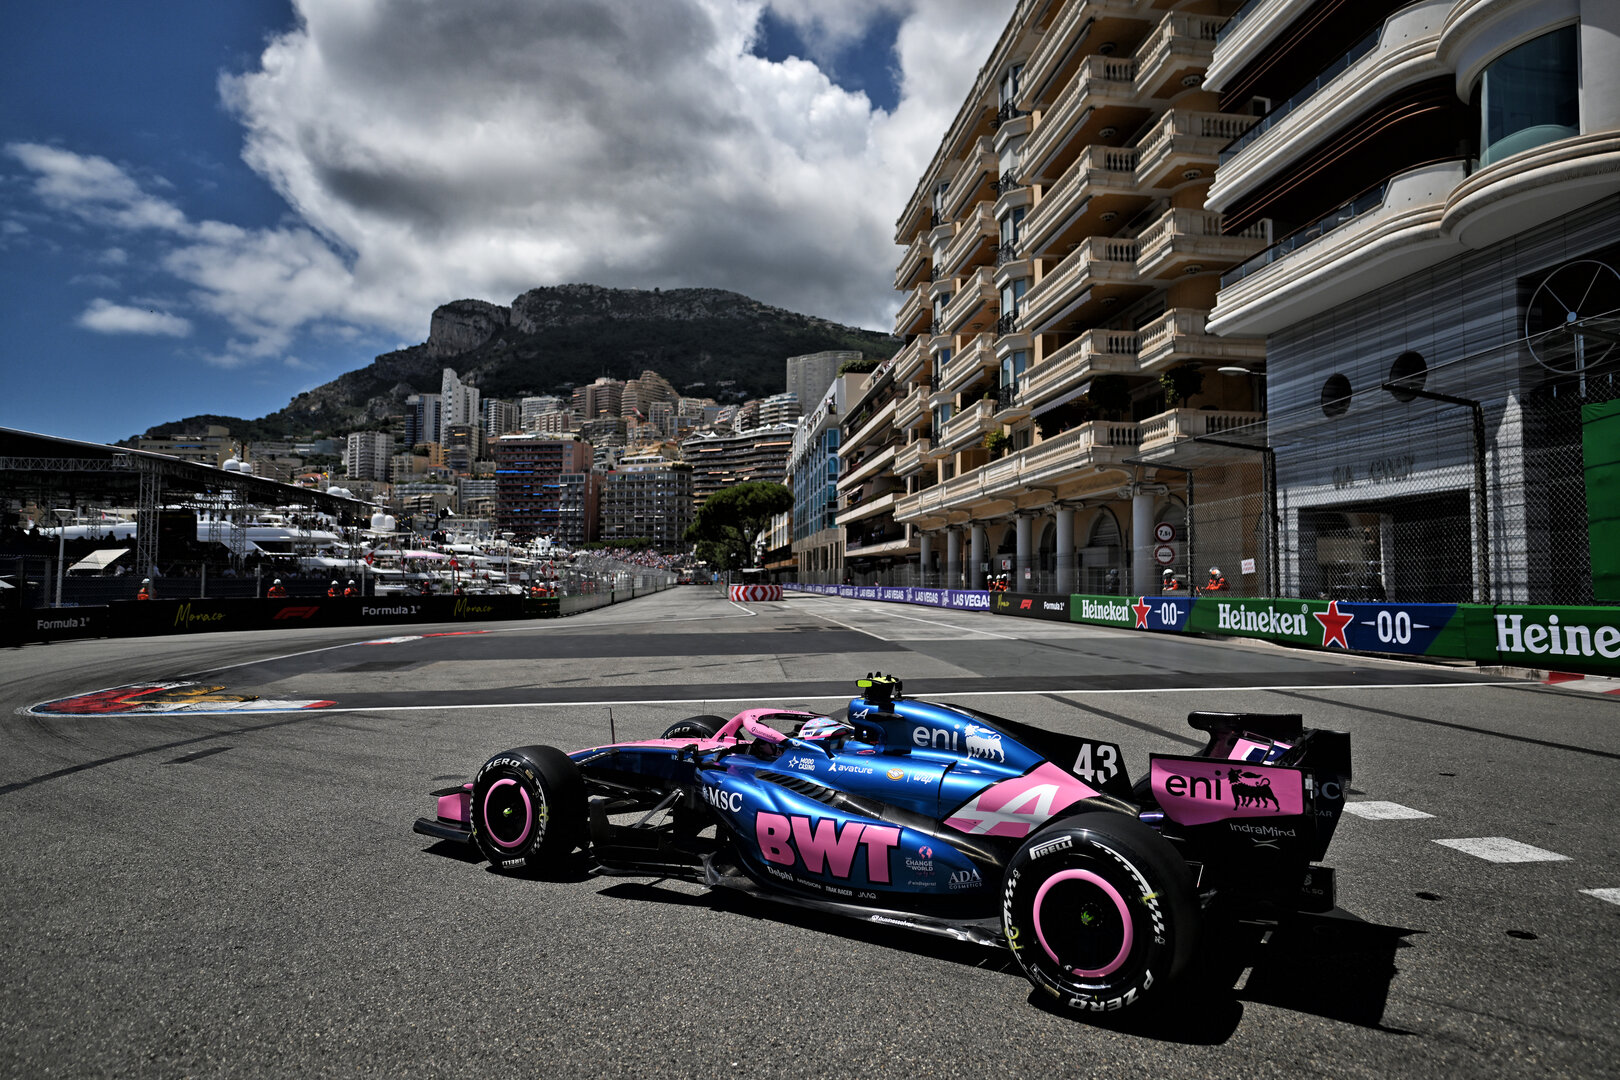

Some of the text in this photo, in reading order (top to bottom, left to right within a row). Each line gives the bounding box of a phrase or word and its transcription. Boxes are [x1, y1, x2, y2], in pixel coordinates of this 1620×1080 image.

[915, 591, 924, 602] LAS
[924, 592, 938, 603] VEGAS
[953, 594, 964, 606] LAS
[174, 602, 226, 629] Monaco
[362, 605, 408, 616] Formula
[453, 598, 493, 618] Monaco
[1161, 602, 1177, 625] 0.0
[37, 618, 78, 630] Formula
[1377, 610, 1412, 645] 0.0
[1493, 614, 1620, 659] Heine
[912, 724, 958, 751] eni
[485, 758, 521, 772] ZERO
[838, 764, 873, 774] avature
[1073, 743, 1118, 784] 43
[1165, 770, 1222, 800] eni
[708, 786, 743, 812] MSC
[1229, 822, 1296, 837] IndraMind
[755, 810, 903, 885] BWT
[1029, 835, 1073, 860] PIRELLI
[767, 866, 794, 882] Delphi
[948, 868, 982, 883] ADA
[949, 882, 982, 890] COSMETICS
[1068, 987, 1139, 1012] ZERO
